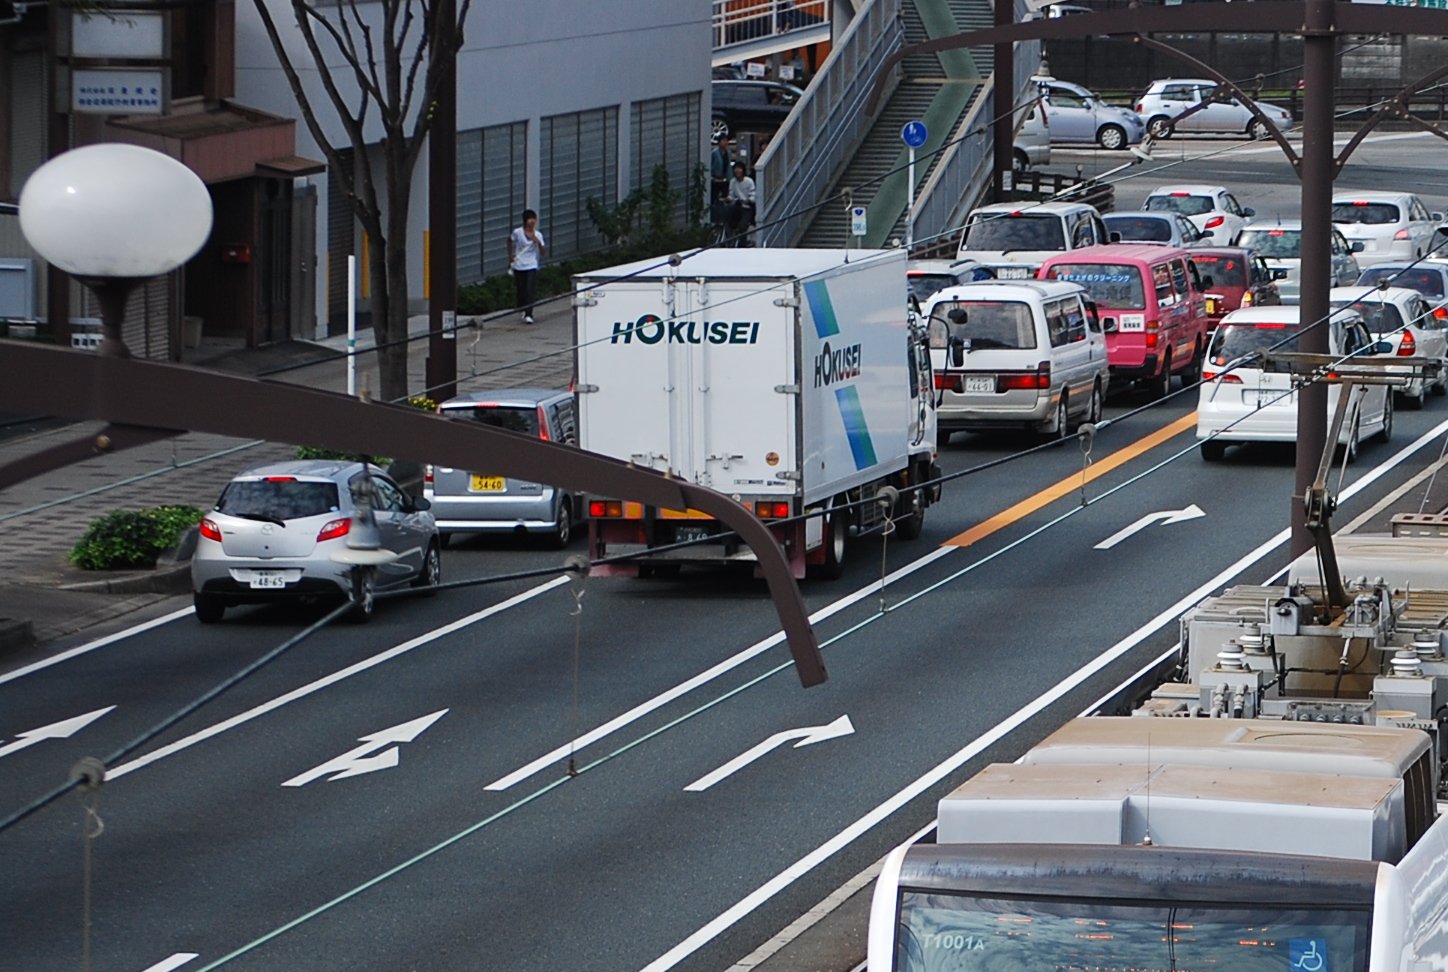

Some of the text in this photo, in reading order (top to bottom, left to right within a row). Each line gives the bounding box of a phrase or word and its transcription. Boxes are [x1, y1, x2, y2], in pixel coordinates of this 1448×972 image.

[611, 314, 760, 344] HOKUSEI
[814, 341, 861, 388] HOKUSEI
[478, 480, 502, 490] 54-60
[922, 934, 984, 950] T1001A
